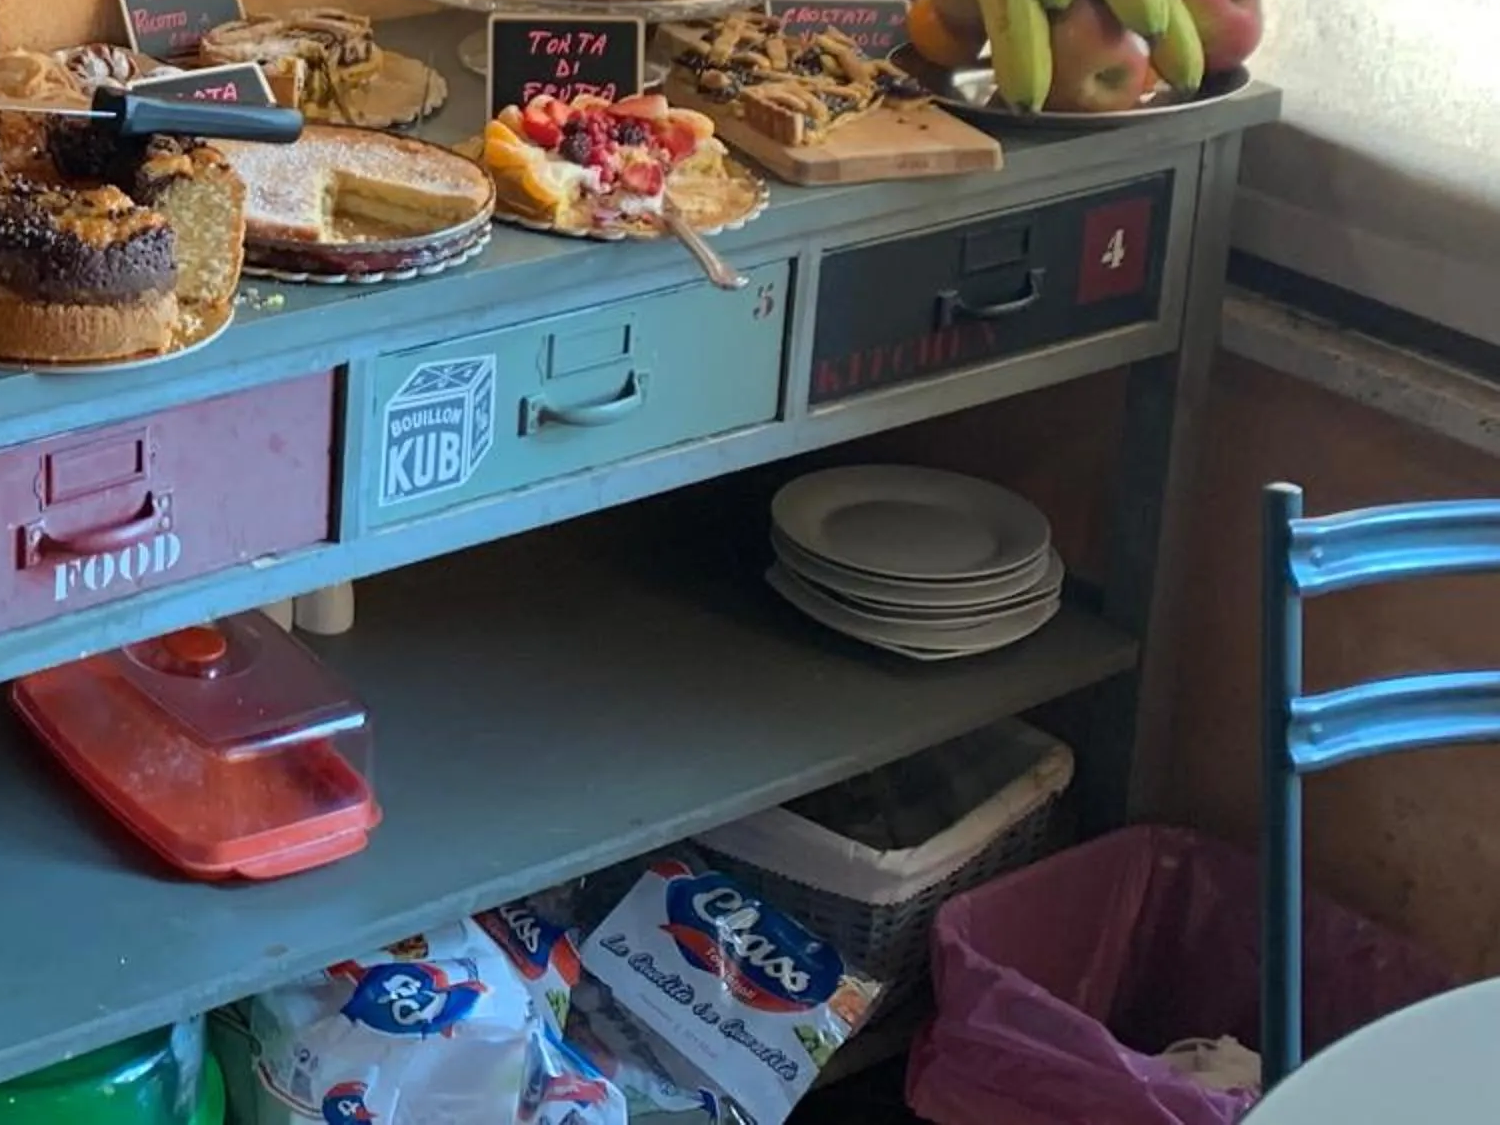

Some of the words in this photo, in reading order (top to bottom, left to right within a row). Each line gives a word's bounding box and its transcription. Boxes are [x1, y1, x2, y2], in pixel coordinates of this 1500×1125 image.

[528, 29, 609, 56] TORTA
[556, 58, 580, 78] DI
[1101, 227, 1127, 270] 4
[752, 282, 776, 320] 5
[390, 407, 463, 439] BOUILLON
[387, 430, 462, 497] KUB
[54, 532, 181, 602] FOOD
